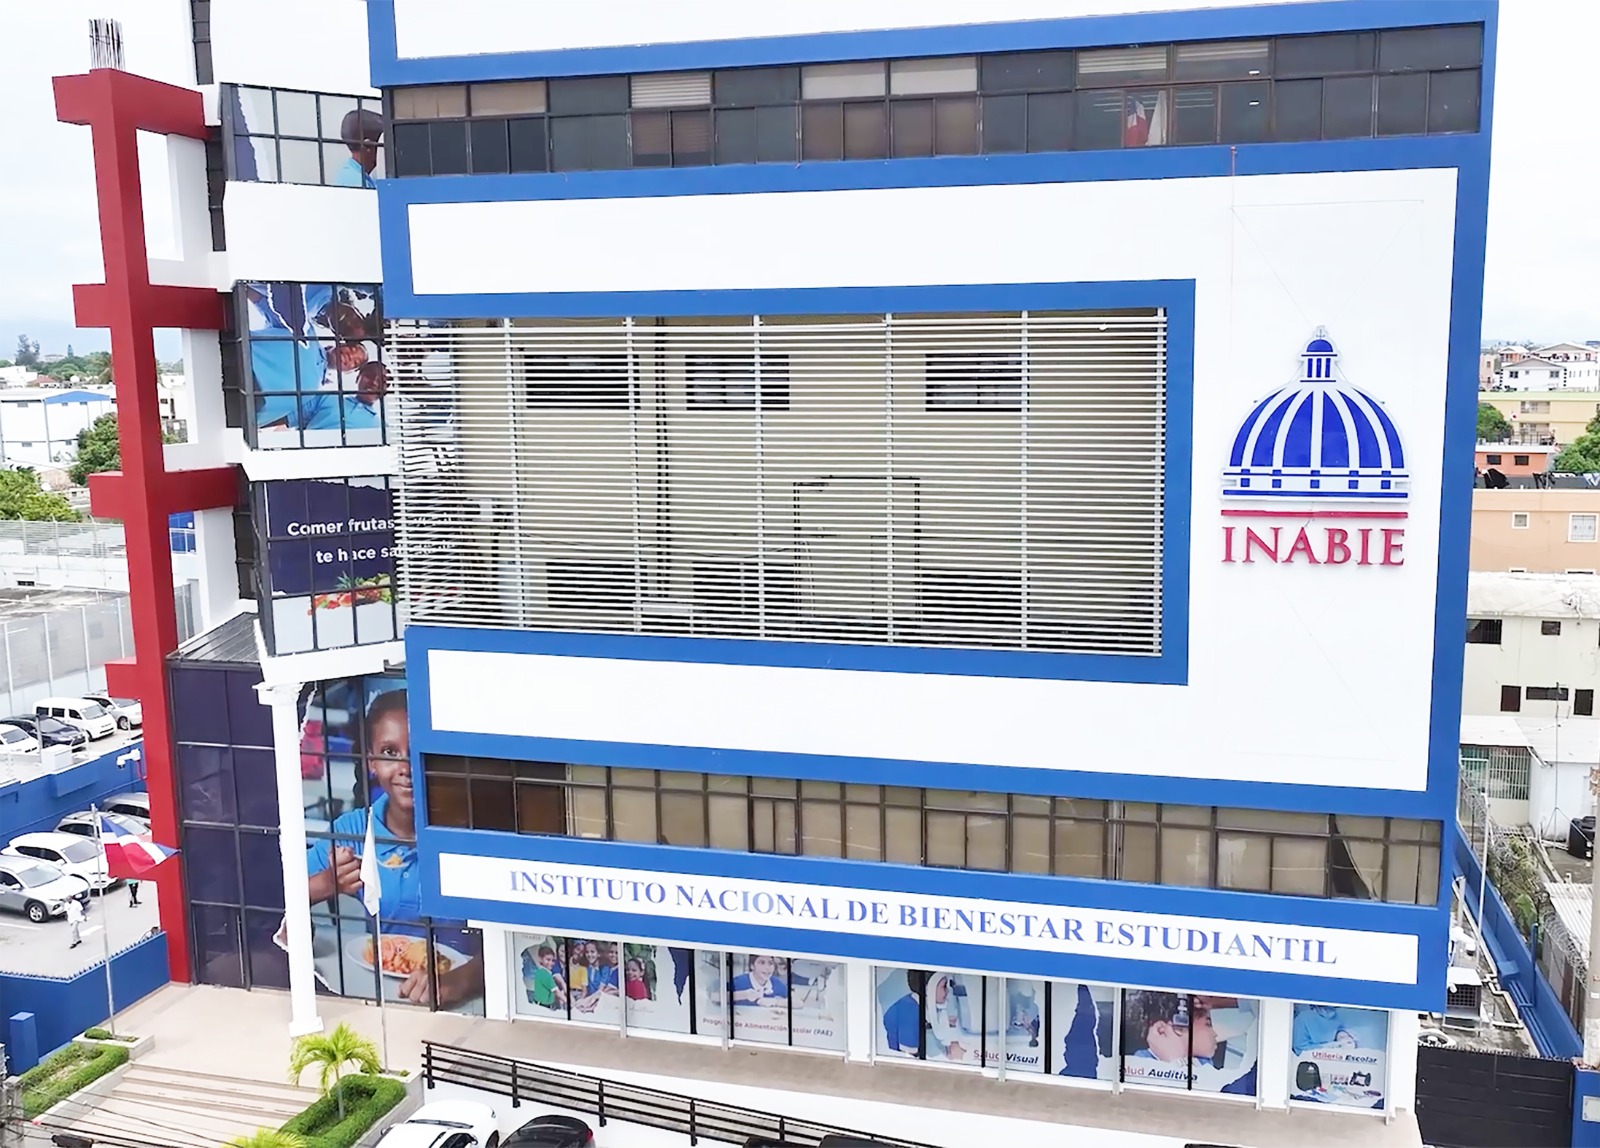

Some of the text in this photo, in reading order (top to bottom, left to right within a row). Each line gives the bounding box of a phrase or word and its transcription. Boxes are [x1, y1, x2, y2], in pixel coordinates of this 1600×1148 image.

[287, 522, 344, 536] Comer
[348, 518, 395, 532] frutas
[1221, 526, 1405, 567] INABIE
[315, 551, 334, 563] te
[509, 870, 1338, 966] INSTITUTO NACIONAL DE BIENESTAR ESTUDIANTIL
[1006, 1052, 1039, 1064] Visual
[1345, 1054, 1377, 1063] Escolar
